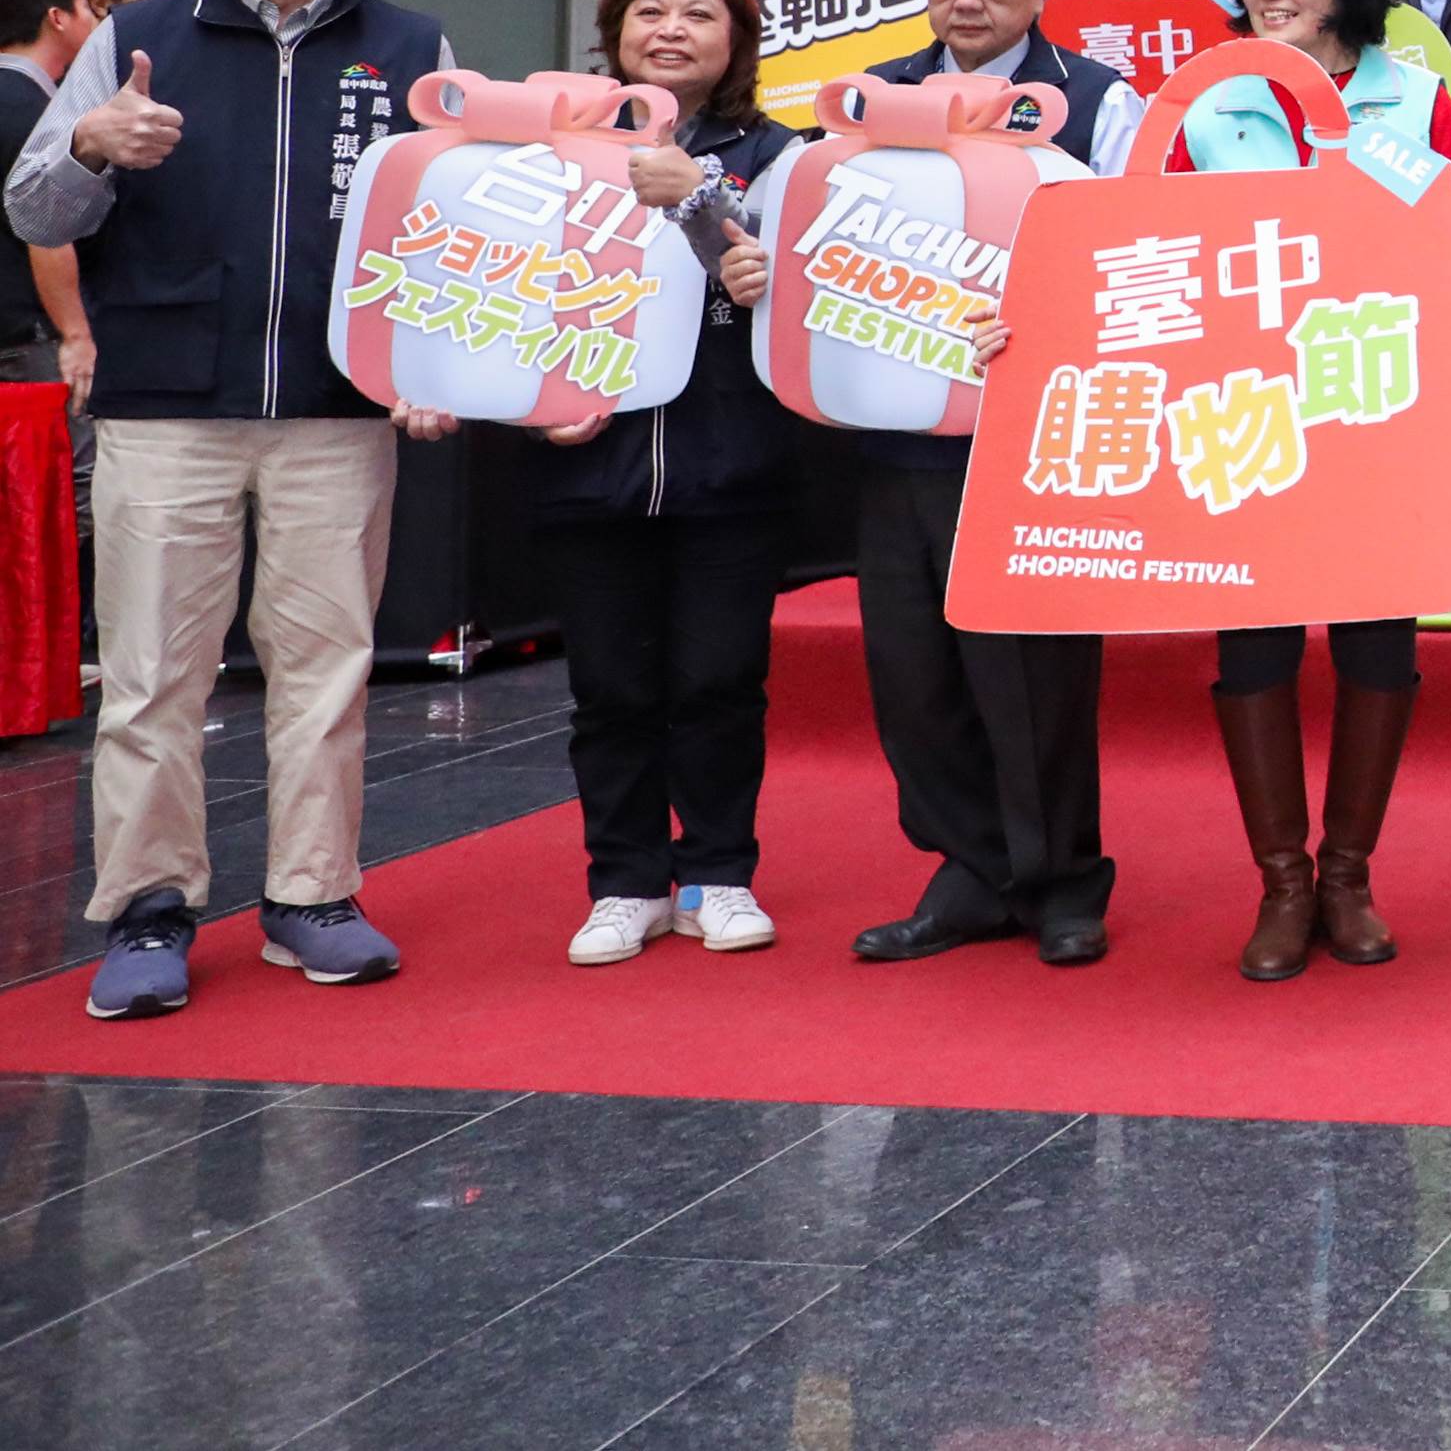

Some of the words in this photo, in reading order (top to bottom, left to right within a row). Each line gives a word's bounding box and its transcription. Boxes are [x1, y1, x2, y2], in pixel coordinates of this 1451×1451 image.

[1078, 19, 1194, 77] 臺中
[340, 95, 356, 128] 局長
[462, 142, 668, 254] 台中
[1361, 130, 1432, 187] SALE
[392, 200, 661, 327] ショッピング
[1093, 218, 1320, 354] 臺中
[343, 249, 641, 398] フェスティバル
[1023, 291, 1420, 516] 購物節
[1007, 554, 1138, 581] SHOPPING
[1141, 558, 1255, 586] FESTIVAL
[1012, 525, 1144, 551] TAICHUNG
